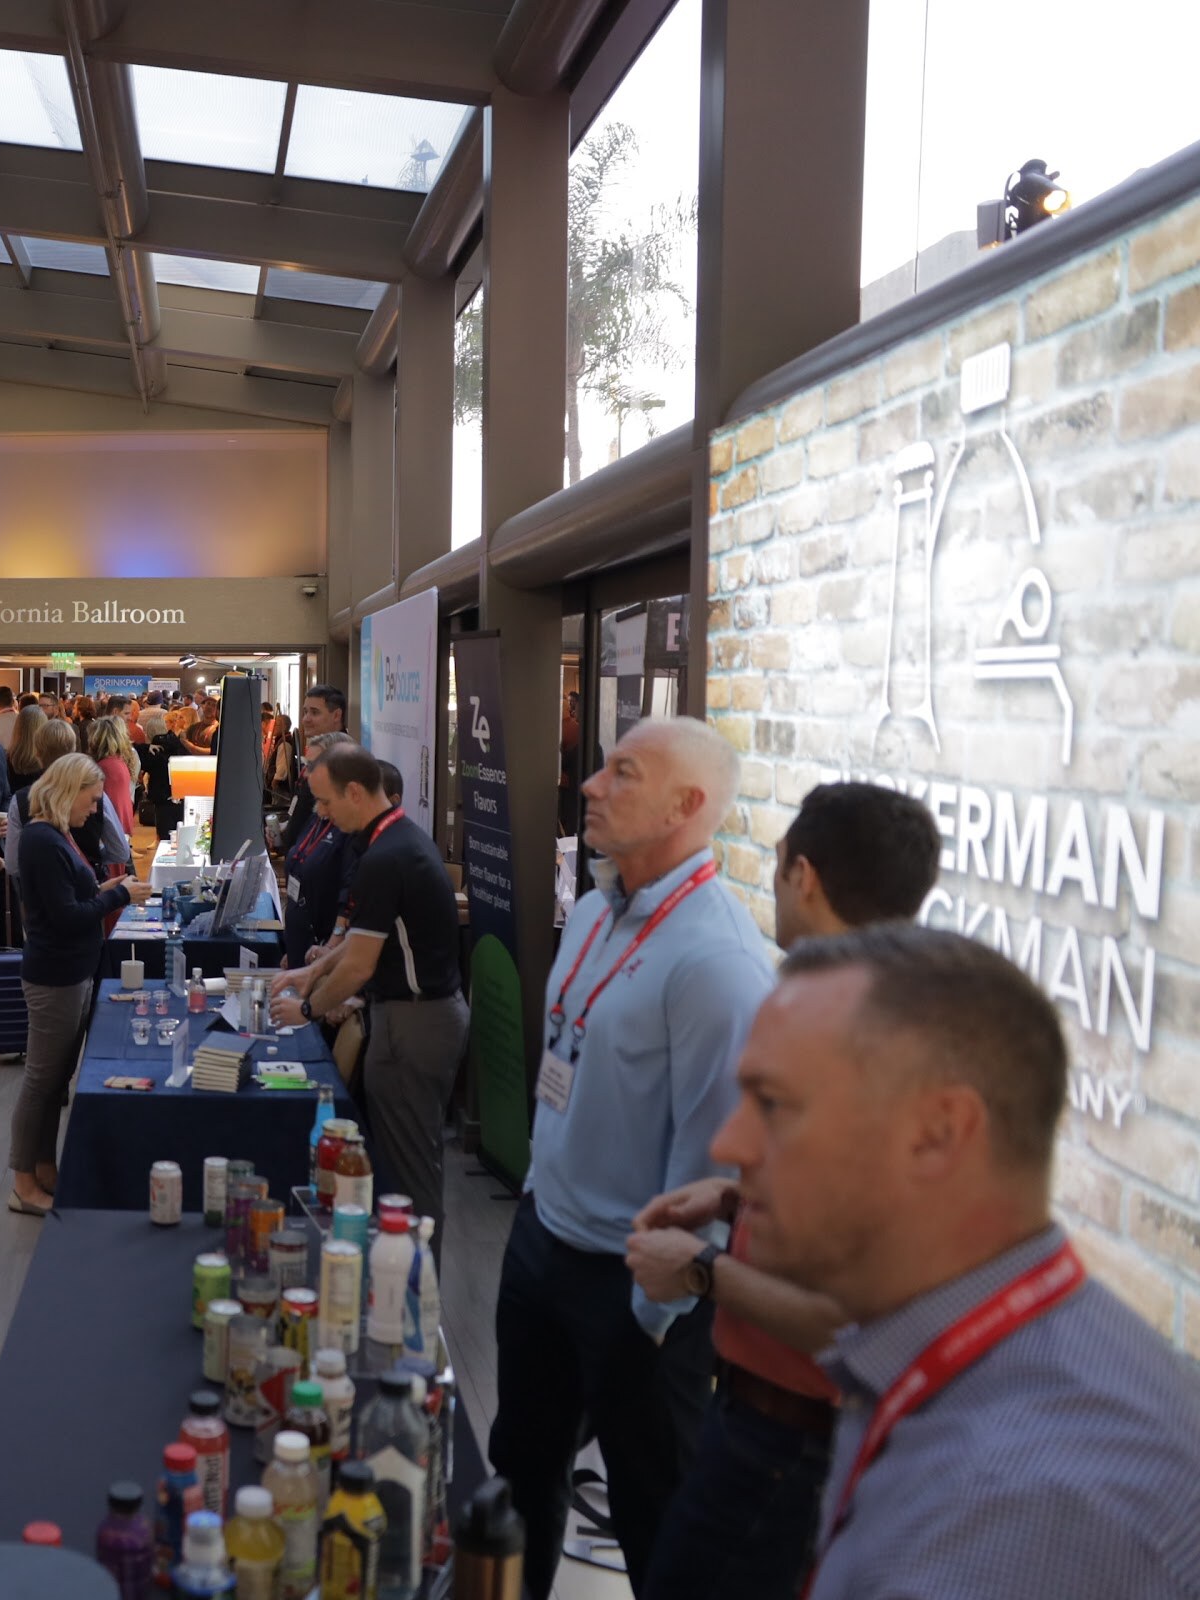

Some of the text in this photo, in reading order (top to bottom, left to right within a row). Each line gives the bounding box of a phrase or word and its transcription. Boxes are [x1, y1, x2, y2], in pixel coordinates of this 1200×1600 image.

[72, 601, 186, 625] Ballroom
[100, 678, 143, 687] DRINKPAK
[386, 656, 420, 702] BevSource
[461, 760, 507, 785] ZoomEssence
[474, 791, 497, 814] Flavors
[468, 835, 509, 861] Born sustainable
[469, 862, 483, 879] Better
[483, 867, 498, 884] flavor
[498, 872, 506, 888] for
[472, 884, 511, 912] healthier planet
